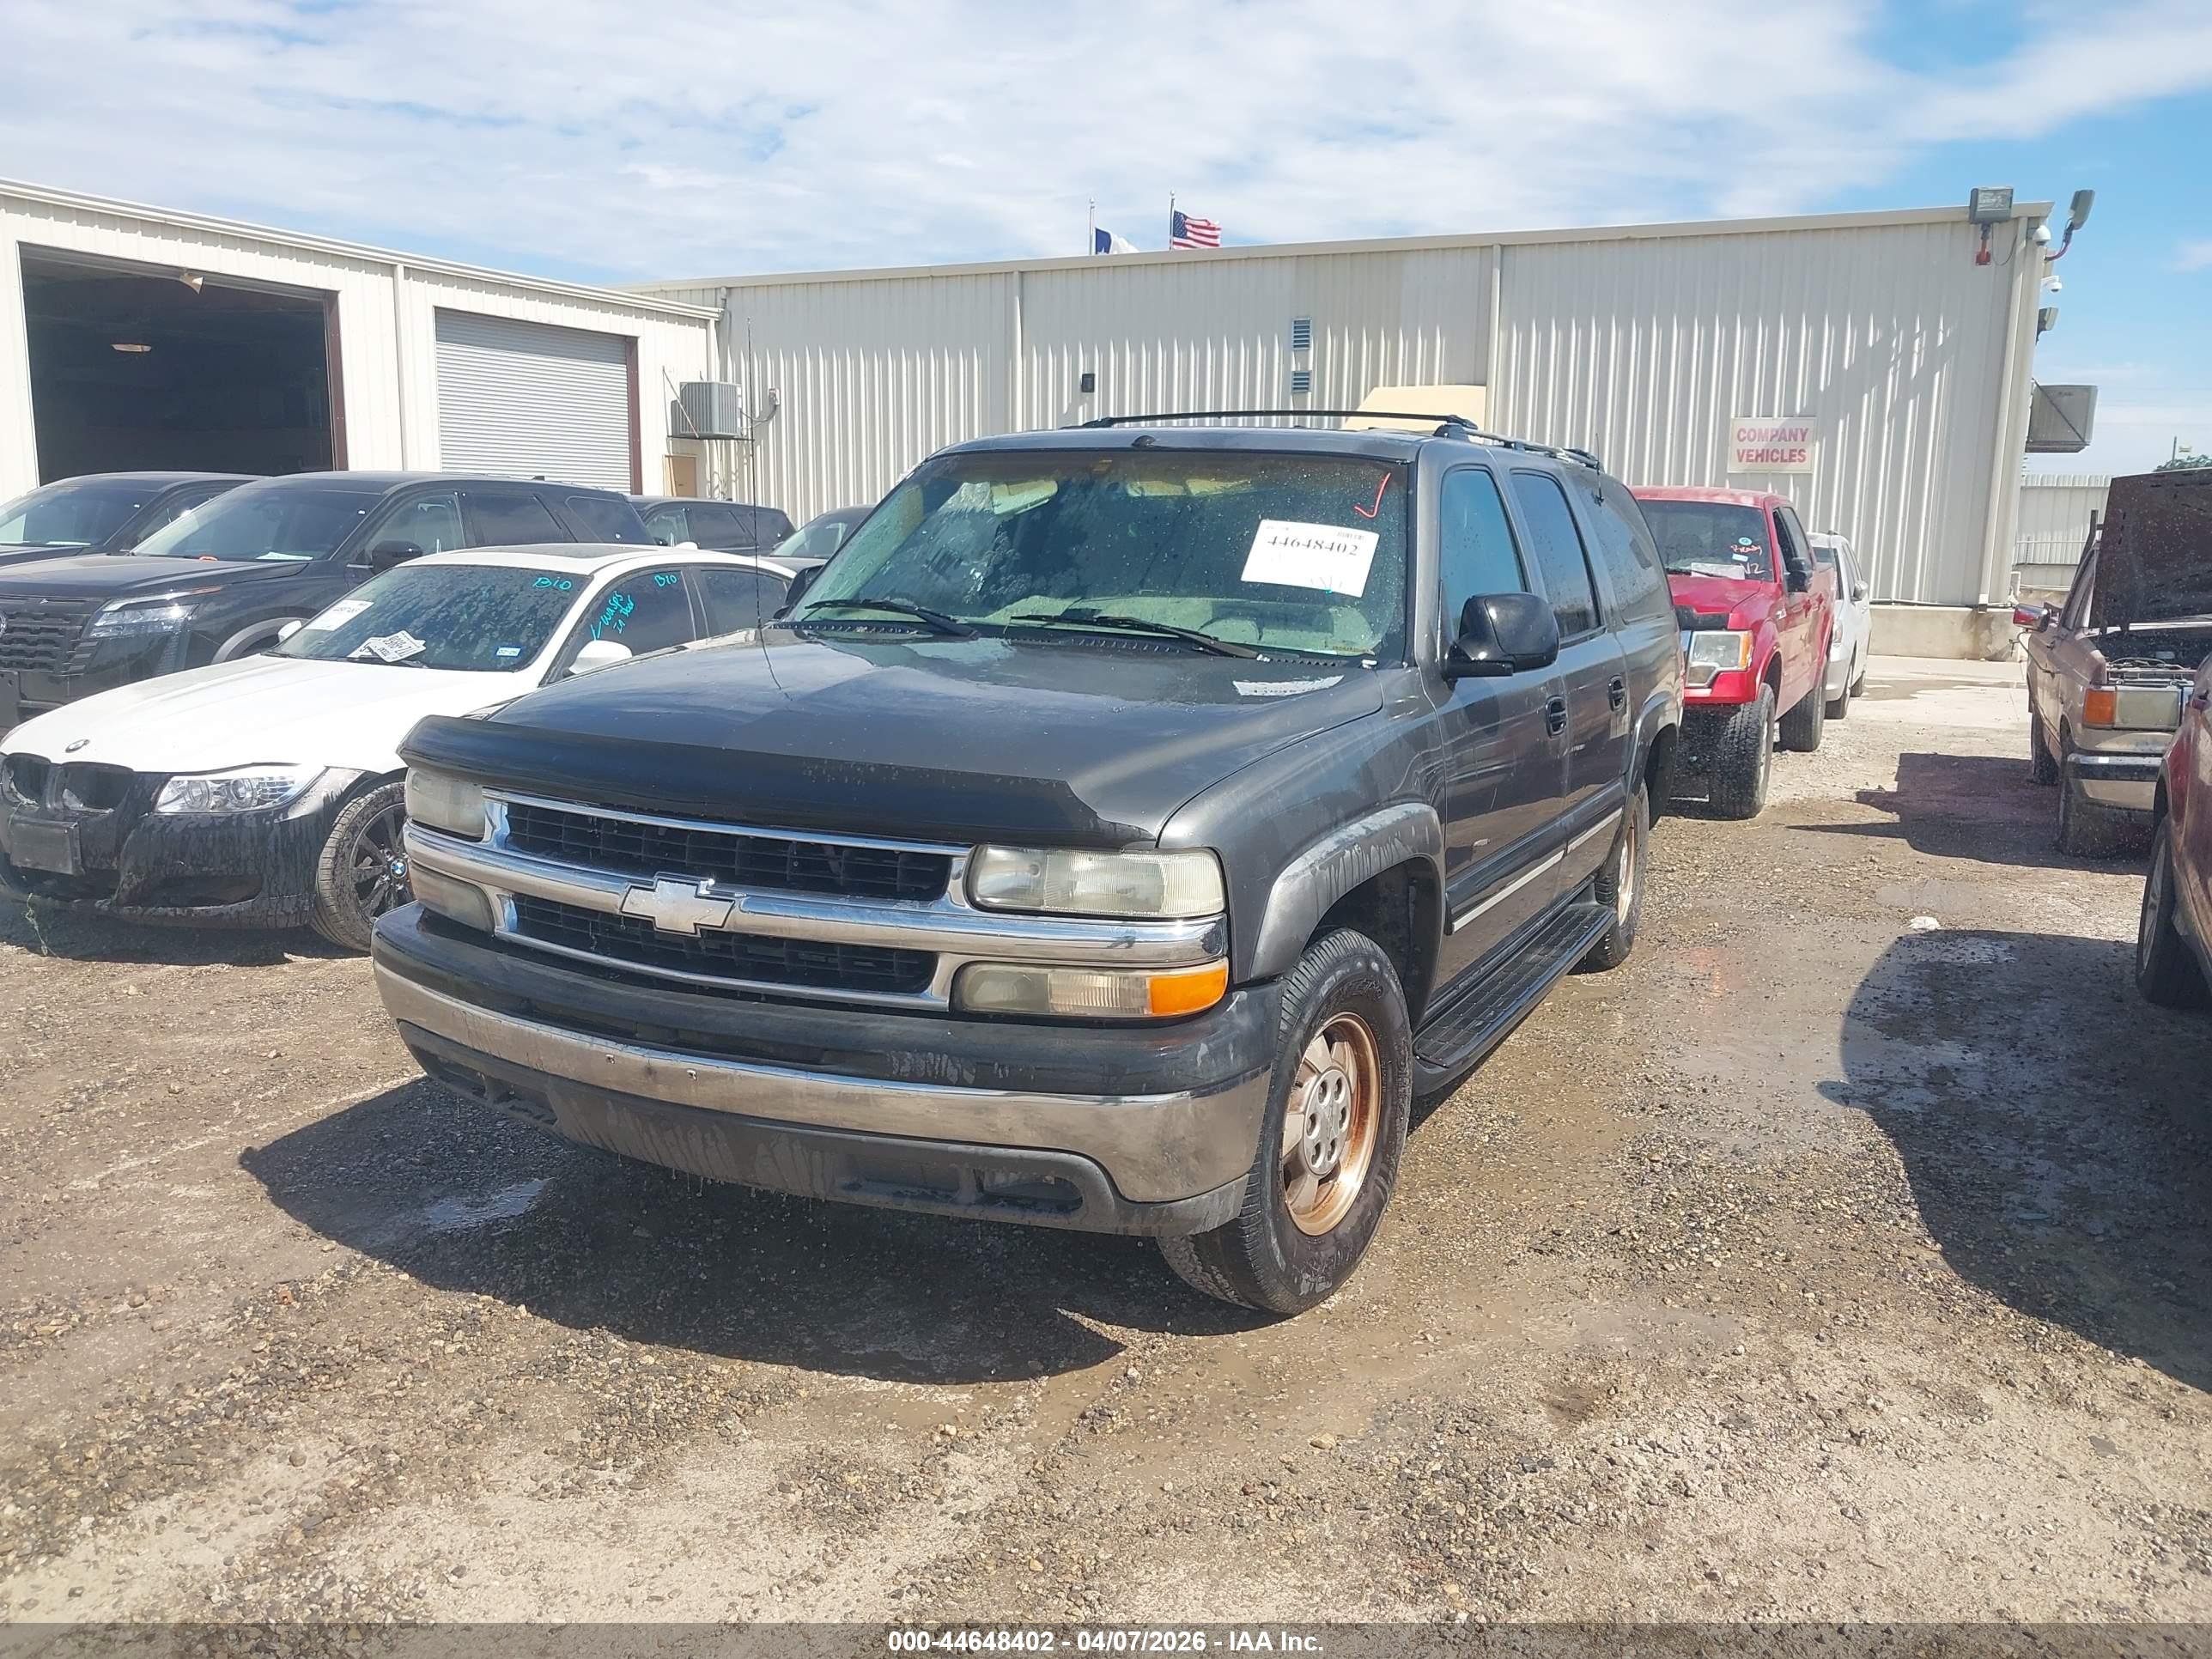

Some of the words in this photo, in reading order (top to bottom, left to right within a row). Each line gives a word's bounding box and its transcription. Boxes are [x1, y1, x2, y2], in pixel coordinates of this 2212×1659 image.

[1737, 428, 1808, 442] COMPANY
[1736, 448, 1808, 463] VEHICLES
[1267, 535, 1358, 556] 44648402
